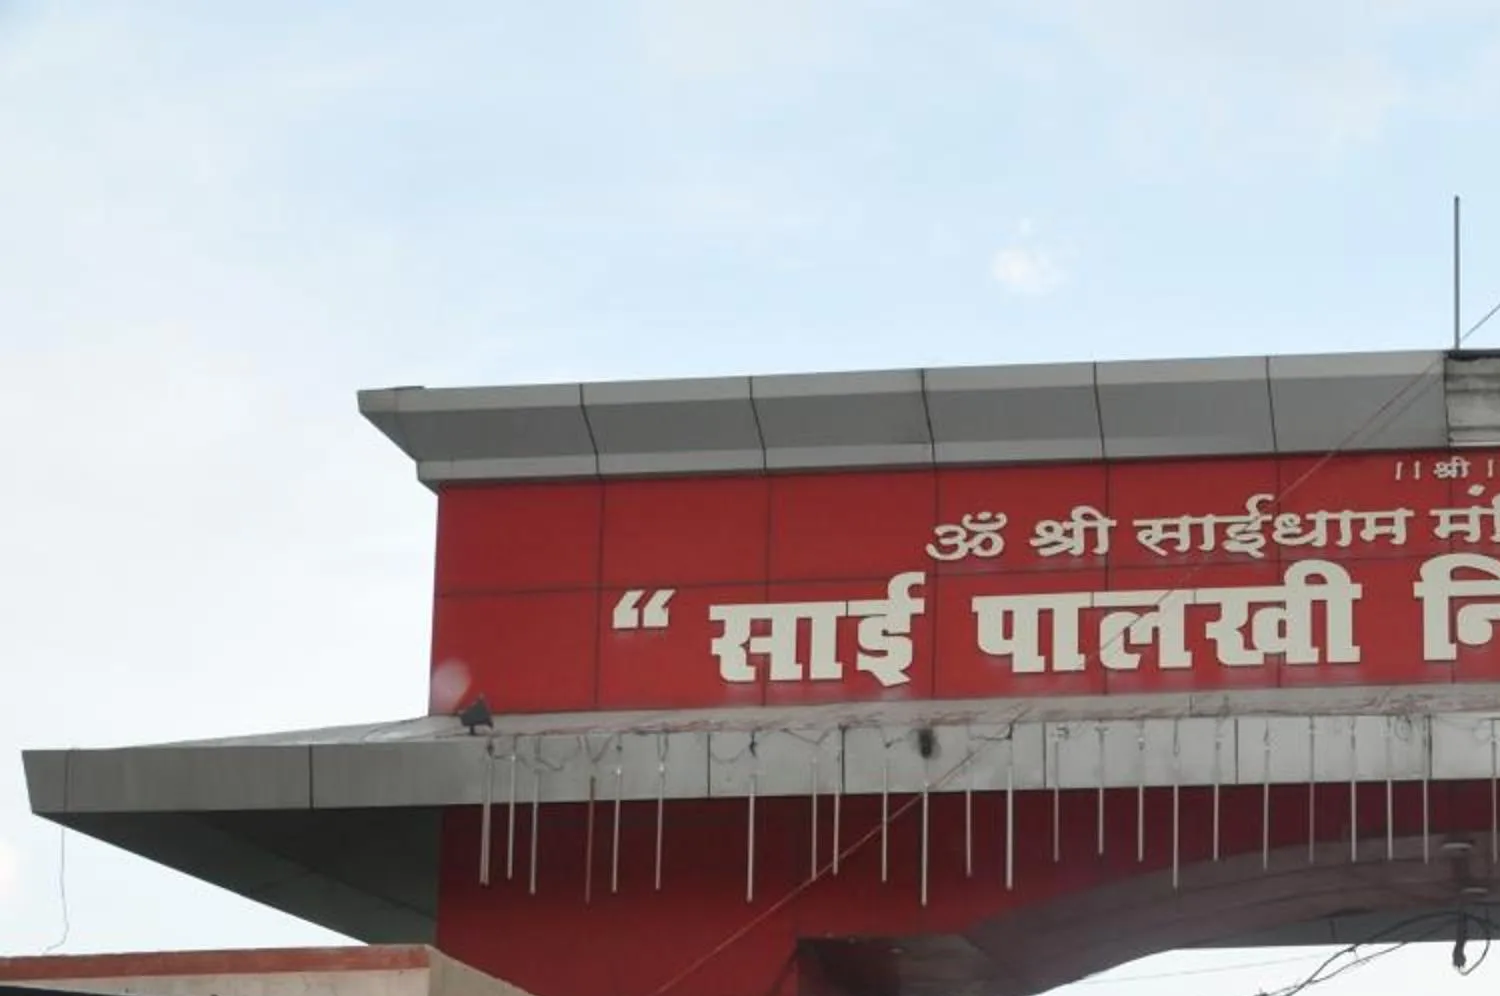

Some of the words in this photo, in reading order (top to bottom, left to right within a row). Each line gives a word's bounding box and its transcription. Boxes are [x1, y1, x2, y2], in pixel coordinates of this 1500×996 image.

[1433, 455, 1471, 479] श्री
[925, 511, 1007, 561] ॐ
[1029, 504, 1116, 556] श्री
[1132, 493, 1412, 558] साईधाम
[708, 571, 926, 687] साई
[970, 558, 1362, 674] पालखी
